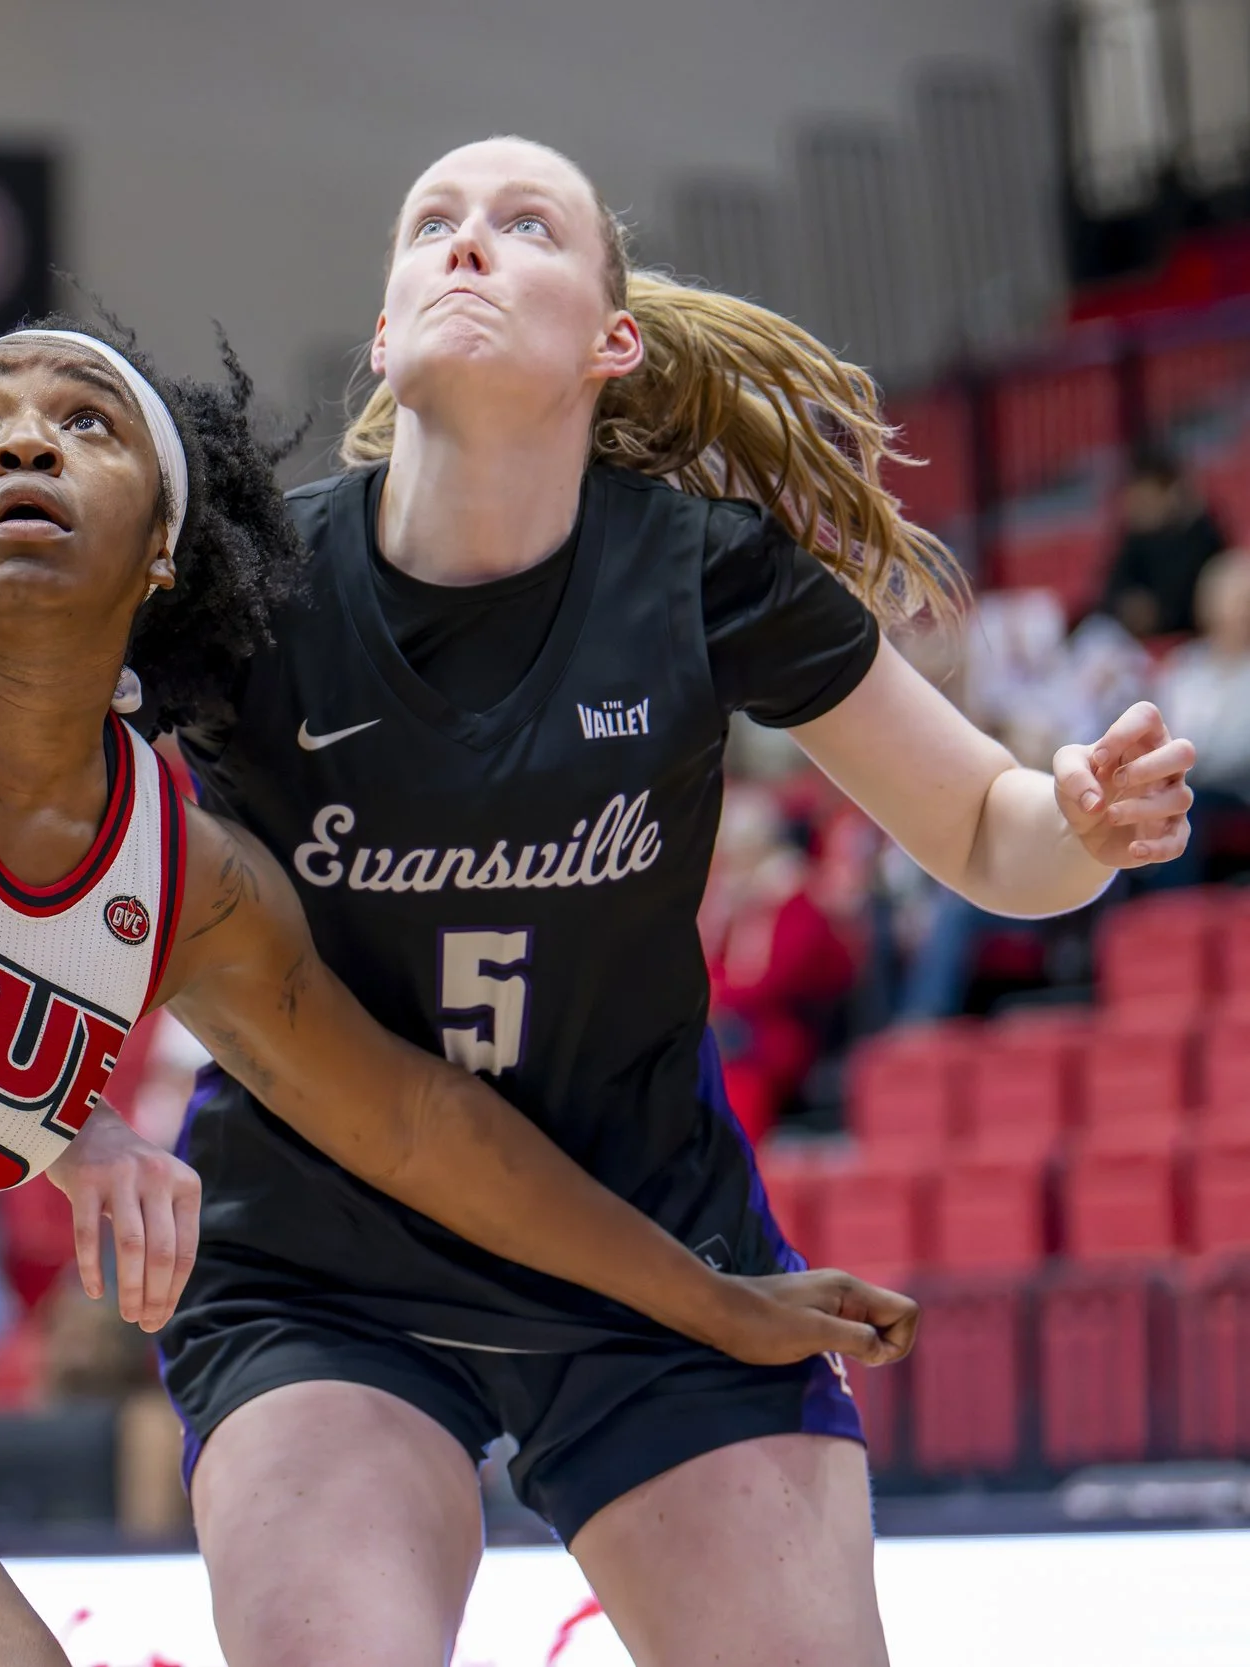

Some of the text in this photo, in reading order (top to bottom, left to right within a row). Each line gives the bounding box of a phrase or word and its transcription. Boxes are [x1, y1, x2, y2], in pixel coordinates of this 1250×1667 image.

[576, 697, 650, 740] VALLEY
[602, 700, 623, 710] THE
[293, 789, 662, 893] Evansville
[112, 906, 143, 936] OVC
[439, 926, 534, 1076] 5
